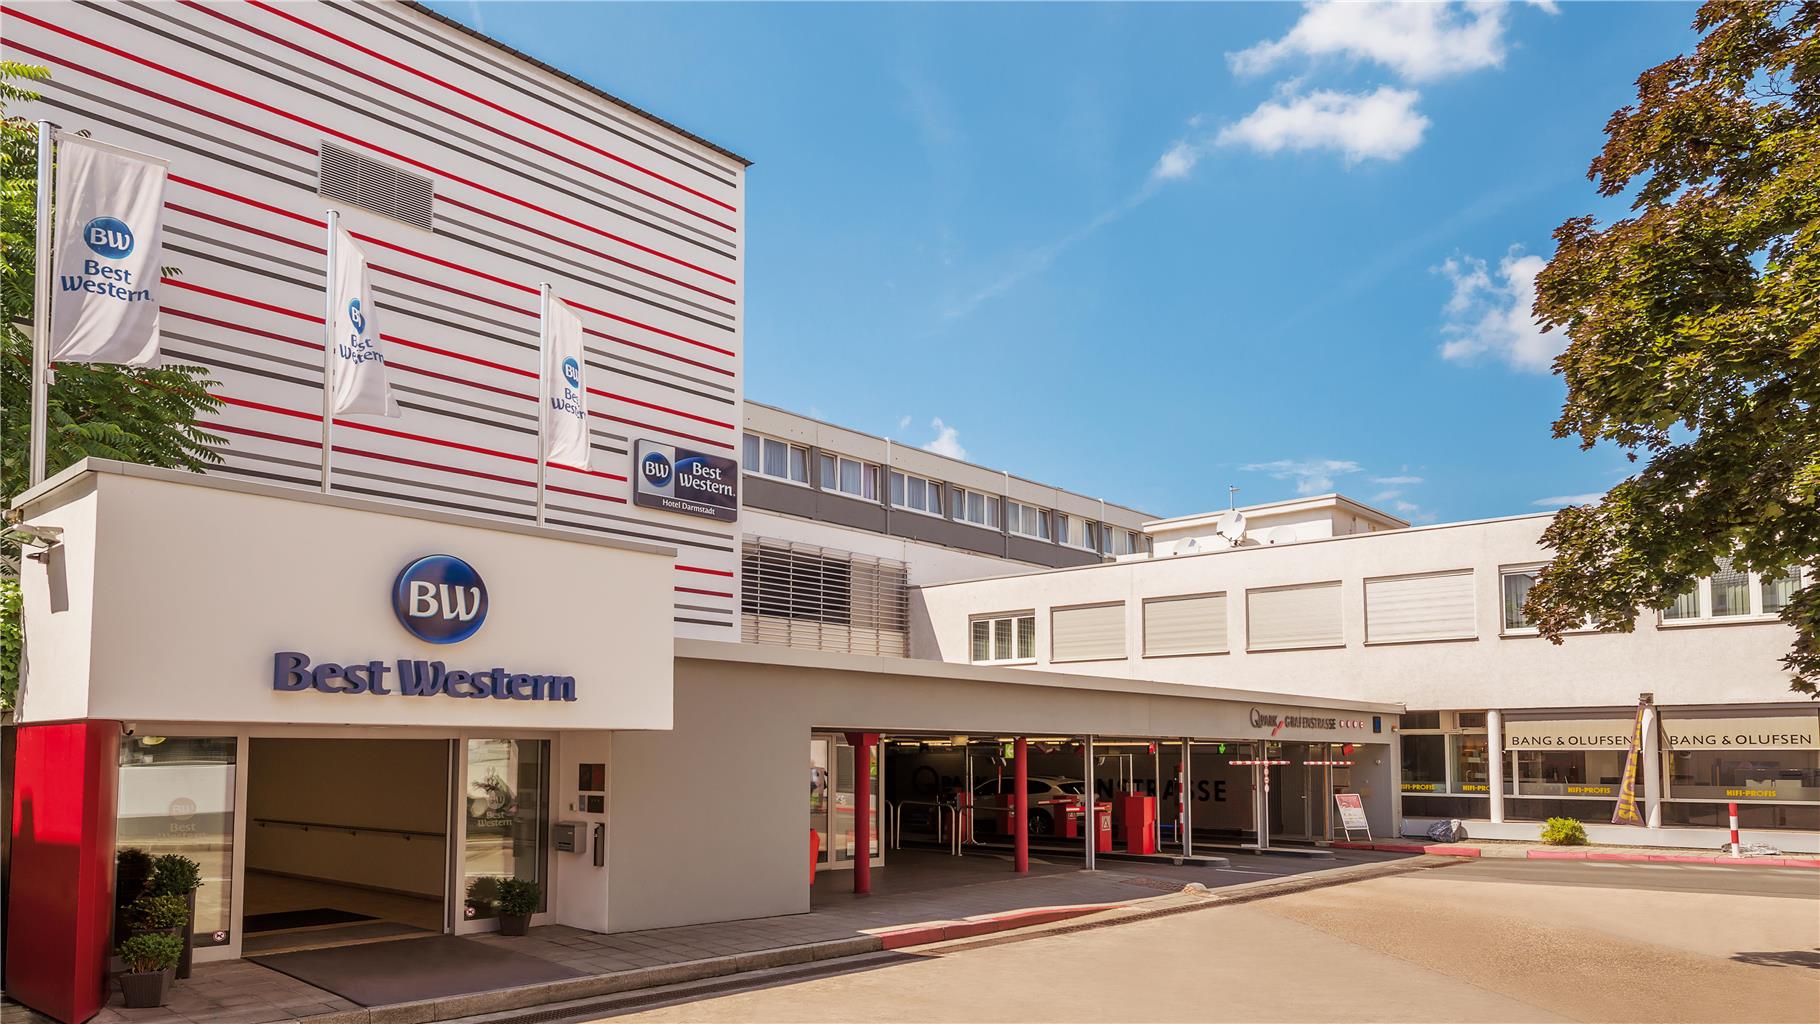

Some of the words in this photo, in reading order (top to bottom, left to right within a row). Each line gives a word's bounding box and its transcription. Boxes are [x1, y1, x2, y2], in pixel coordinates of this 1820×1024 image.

[90, 227, 131, 251] BW
[84, 260, 132, 285] Best
[645, 461, 669, 478] BW
[692, 461, 722, 480] Best
[662, 498, 681, 509] Hotel
[681, 502, 716, 516] Darmstadt
[409, 580, 480, 622] BW
[273, 651, 391, 695] Best
[396, 658, 577, 702] Western
[1512, 736, 1552, 746] BANG
[1556, 736, 1565, 746] &
[1568, 735, 1633, 746] OLUFSEN
[1670, 735, 1717, 745] BANG
[1721, 735, 1732, 745] &
[1735, 734, 1812, 745] OLUFSEN
[1567, 786, 1611, 794] HIFI-PROFIS
[1726, 789, 1777, 797] HIFI-PROFIS
